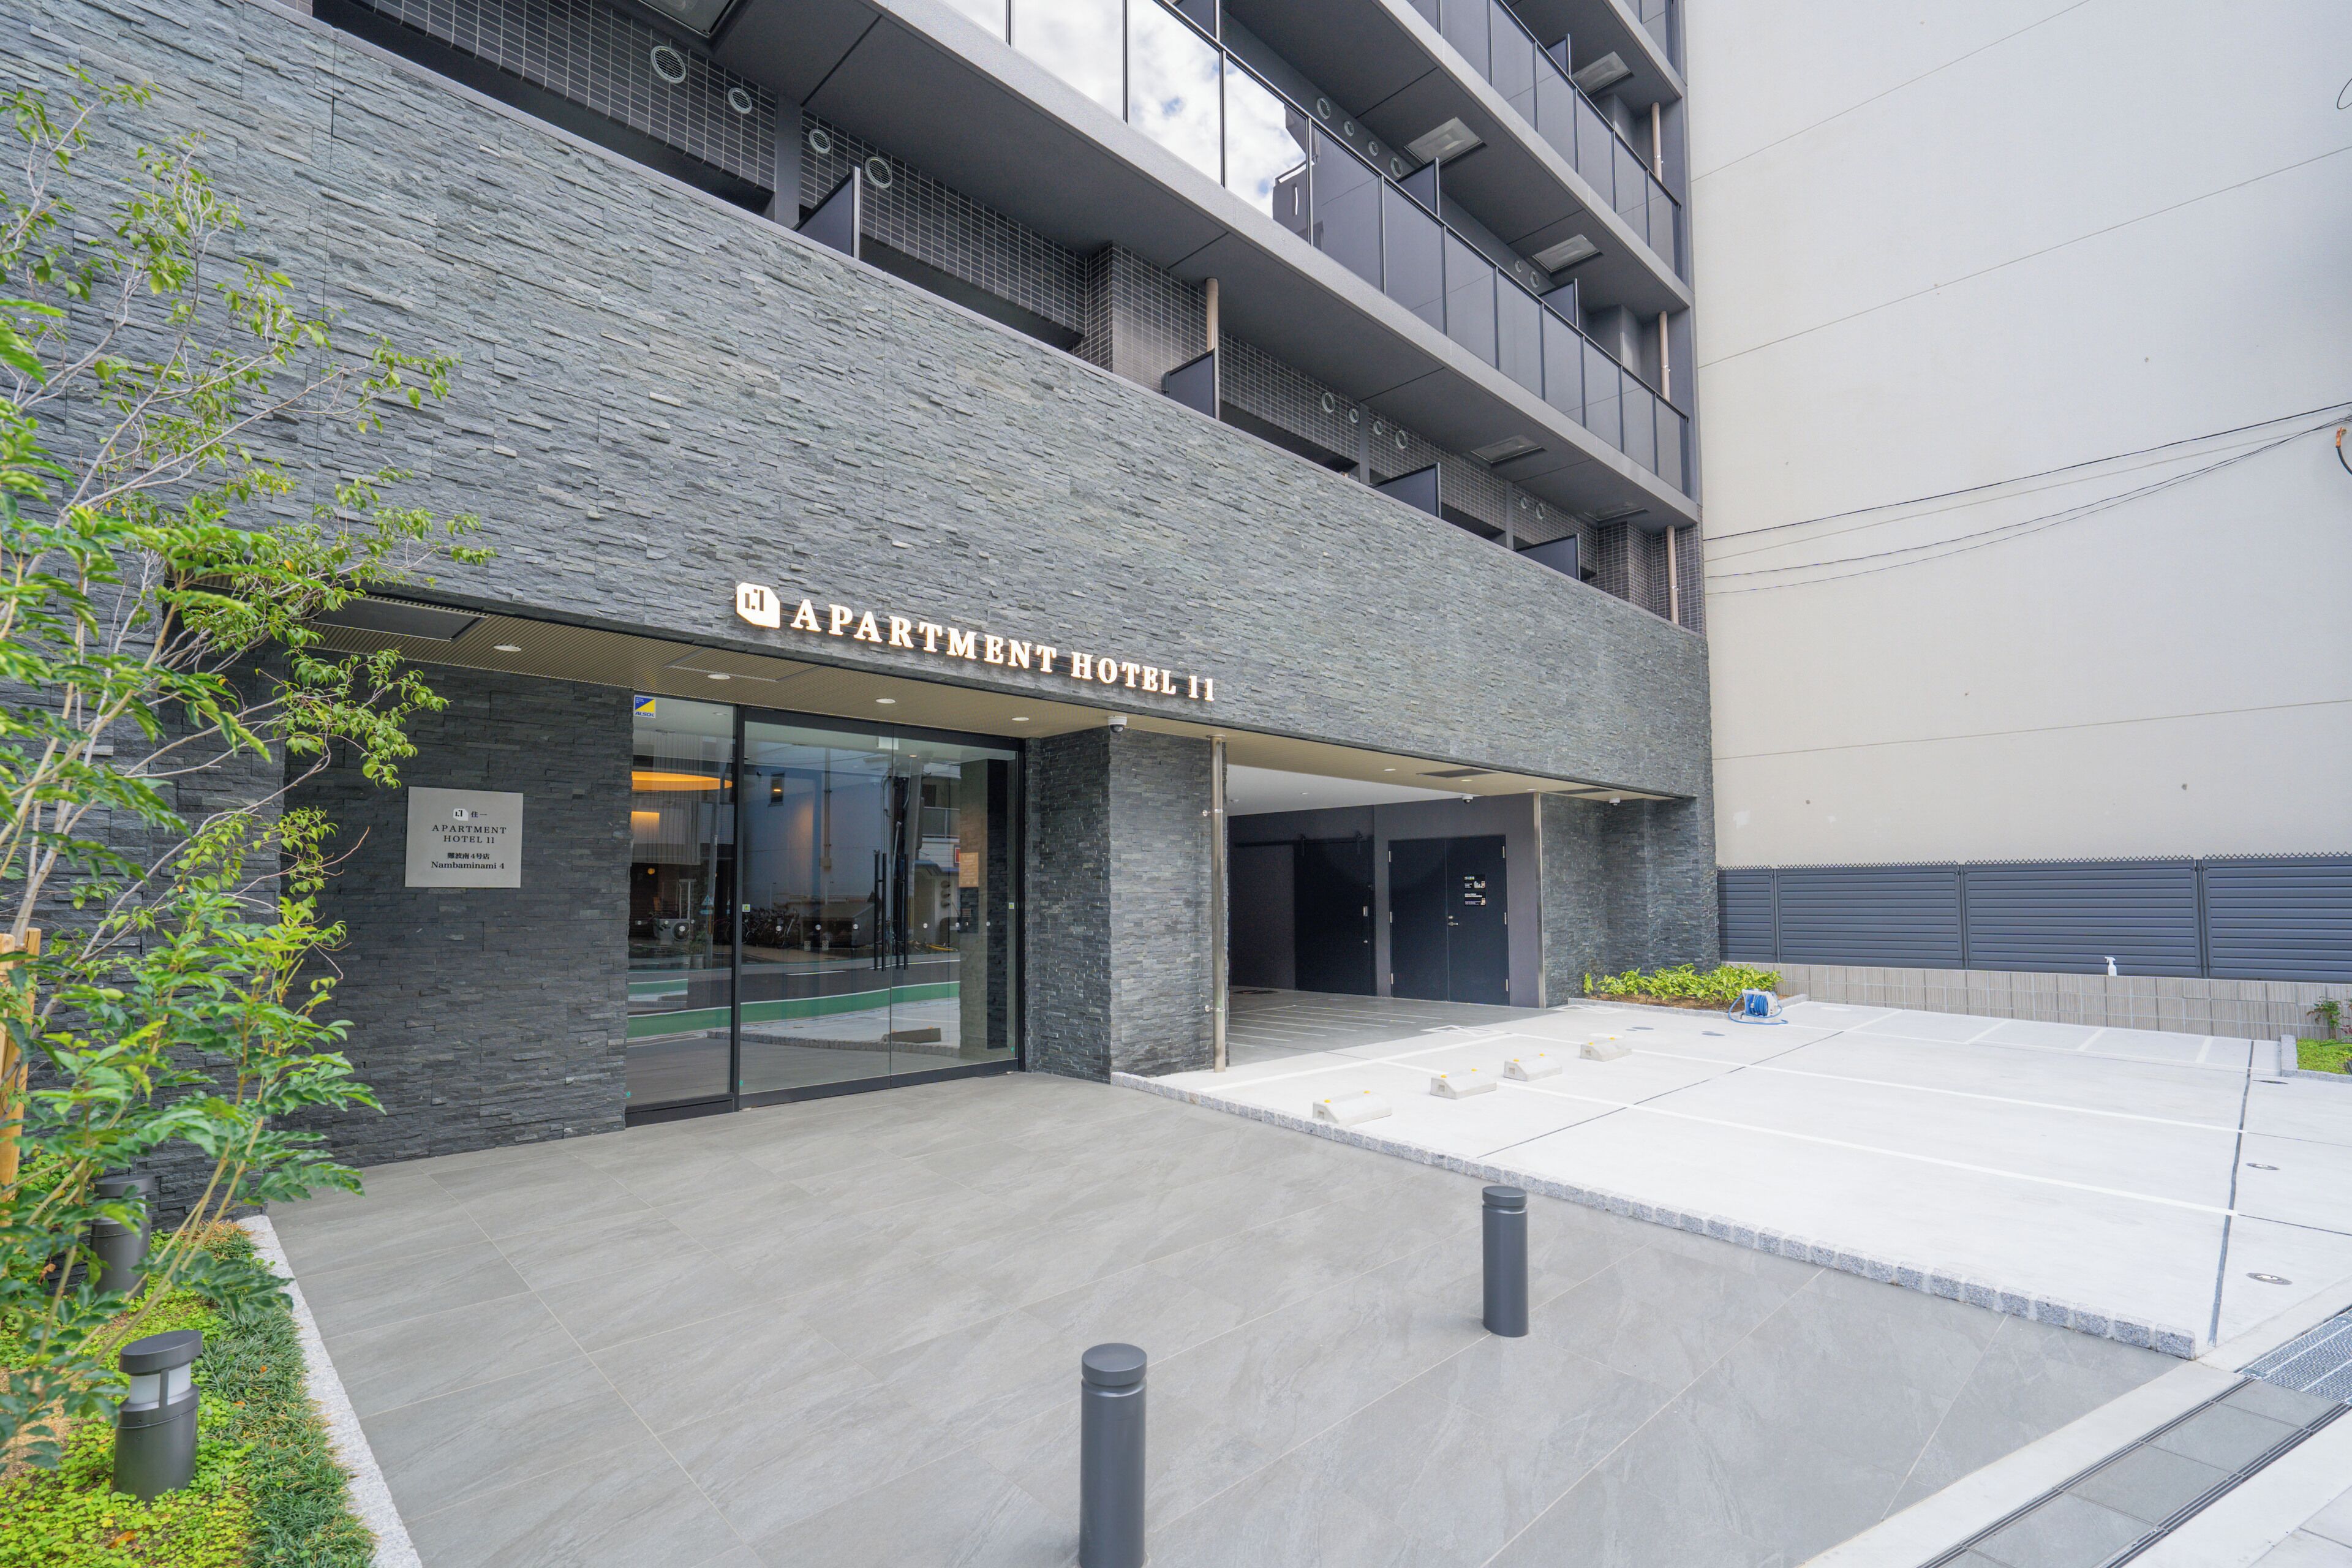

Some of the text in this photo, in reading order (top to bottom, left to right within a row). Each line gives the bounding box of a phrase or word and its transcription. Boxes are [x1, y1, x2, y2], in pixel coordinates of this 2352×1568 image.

[791, 598, 1215, 702] APARTMENT HOTEL 11
[432, 824, 507, 834] APARTMENT
[443, 835, 482, 843] HOTEL
